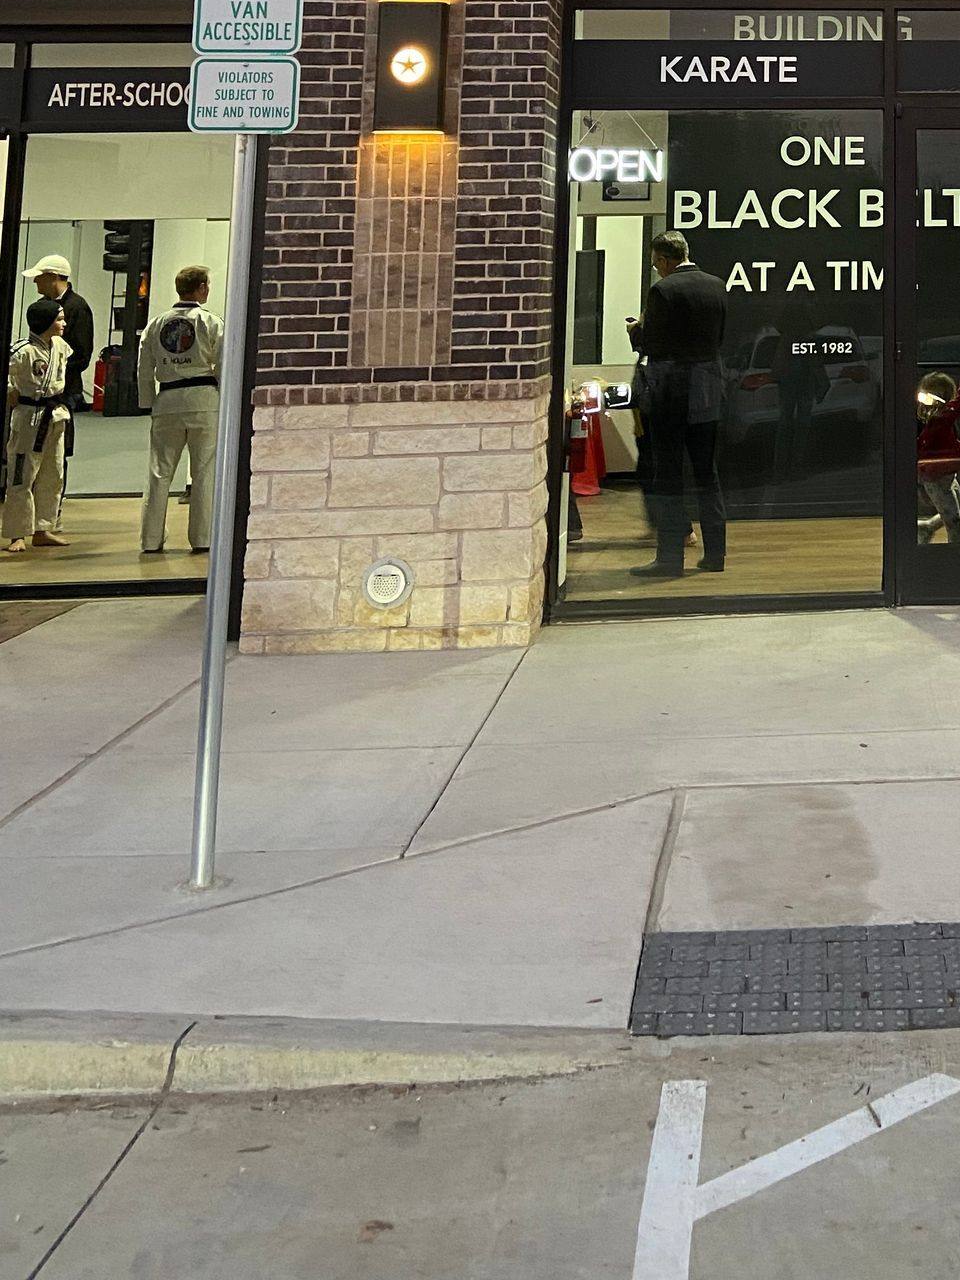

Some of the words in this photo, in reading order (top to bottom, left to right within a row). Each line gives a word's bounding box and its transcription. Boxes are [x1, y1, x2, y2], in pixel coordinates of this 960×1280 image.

[231, 1, 268, 19] VAN
[203, 22, 292, 41] ACCESSIBLE
[218, 71, 274, 84] VIOLATORS
[660, 55, 798, 83] KARATE
[214, 89, 256, 101] SUBJECT
[262, 89, 275, 101] TO
[196, 106, 218, 118] FINE
[223, 106, 244, 118] AND
[249, 106, 290, 118] TOWING
[780, 136, 865, 166] ONE
[568, 148, 663, 182] OPEN
[673, 188, 841, 229] BLACK
[725, 261, 776, 292] AT
[786, 261, 815, 291] A
[826, 260, 884, 291] TIM
[792, 342, 817, 354] EST.
[821, 342, 853, 354] 1982
